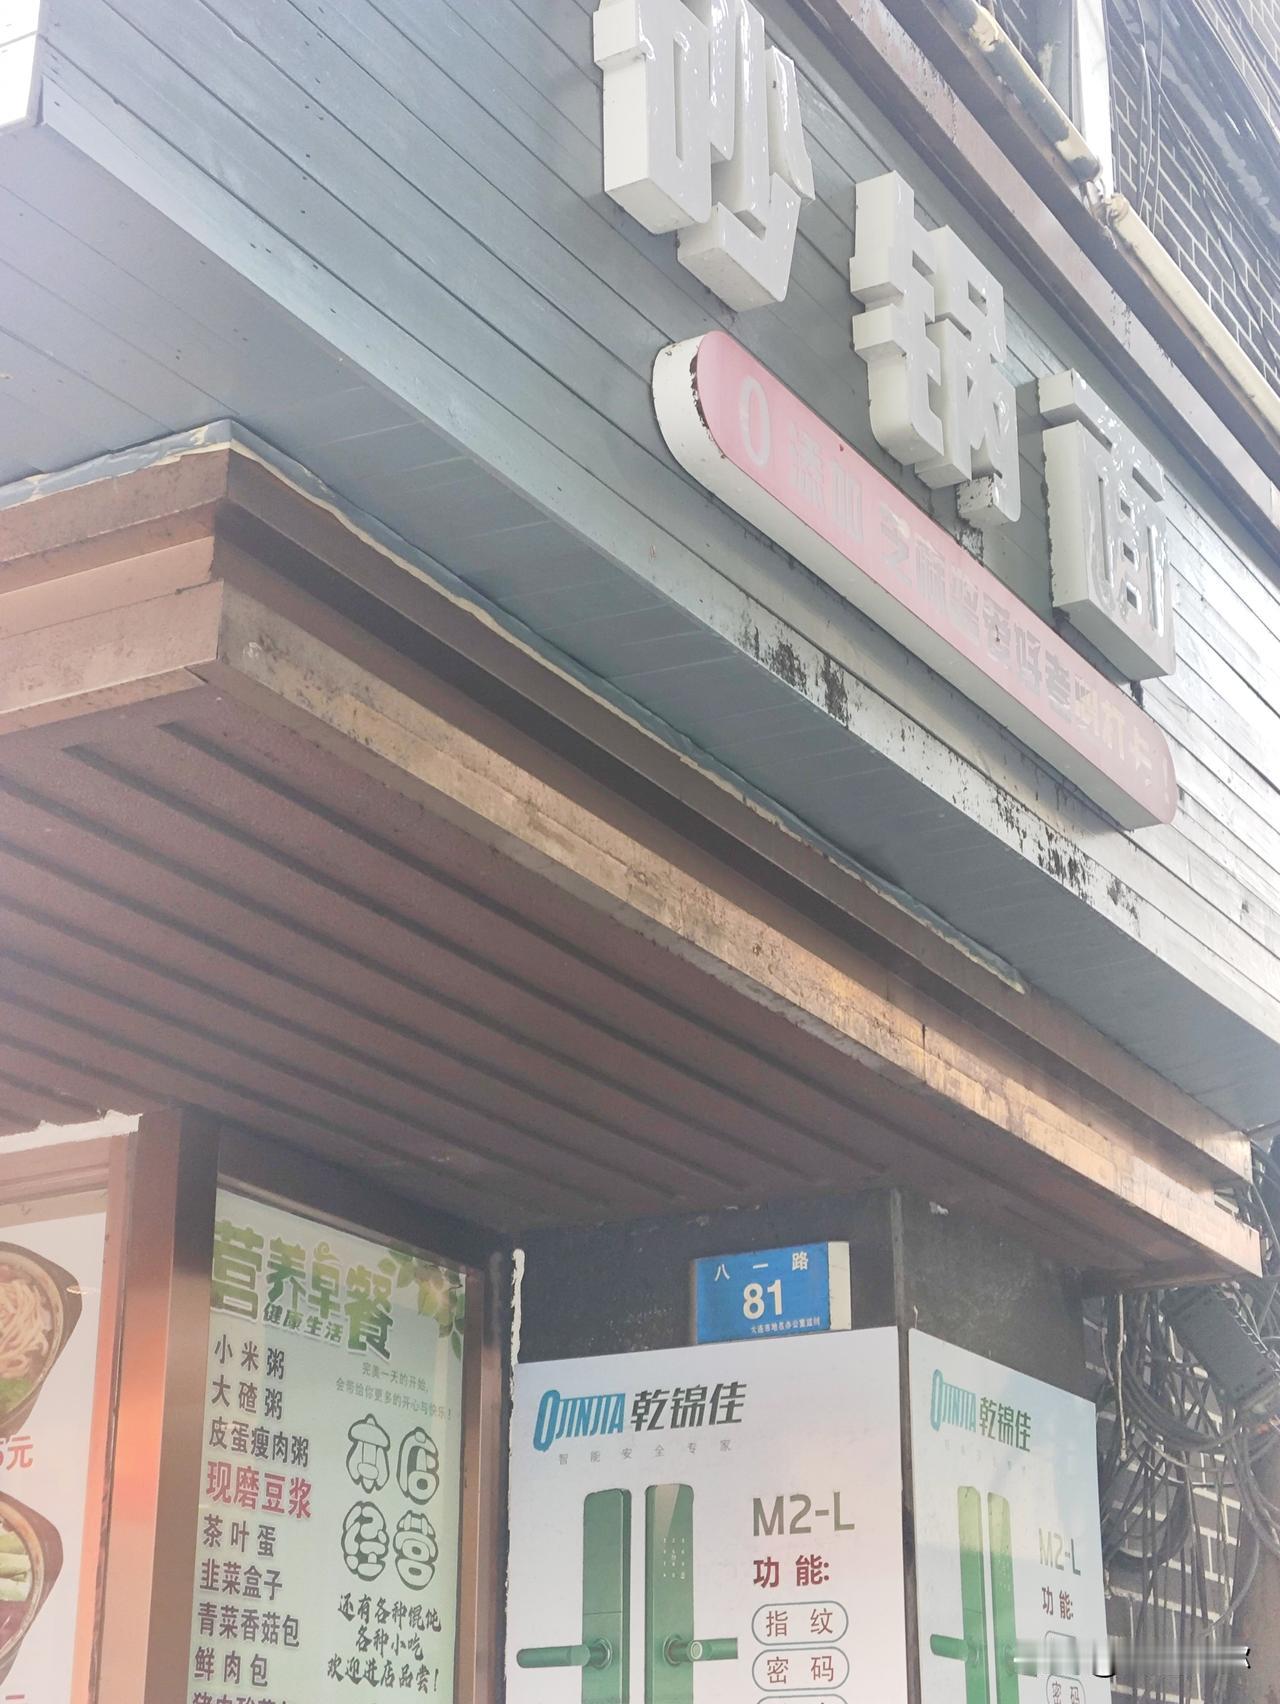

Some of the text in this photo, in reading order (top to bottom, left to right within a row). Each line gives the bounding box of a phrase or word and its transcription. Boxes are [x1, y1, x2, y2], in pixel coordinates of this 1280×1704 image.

[714, 1251, 809, 1282] 八一路
[209, 1219, 394, 1360] 营养早餐
[742, 1279, 783, 1320] 81
[263, 1303, 343, 1344] 健康生活
[214, 1334, 285, 1380] 小米粥
[211, 1374, 283, 1420] 大碴粥
[630, 1381, 748, 1432] 乾锦佳
[209, 1416, 309, 1468] 皮蛋瘦肉粥
[979, 1397, 1032, 1452] 乾锦佳
[346, 1413, 440, 1505] 本店
[559, 1440, 732, 1465] 智能安全专家
[206, 1460, 312, 1520] 现磨豆浆
[203, 1513, 276, 1557] 茶叶蛋
[752, 1491, 855, 1537] M2-L
[341, 1501, 438, 1591] 经营
[1038, 1528, 1082, 1577] M2-L
[199, 1558, 283, 1600] 韭菜盒子
[752, 1554, 830, 1589] 功能:
[197, 1602, 301, 1648] 青菜香菇包
[338, 1592, 441, 1632] 还有各种馄饨
[765, 1608, 833, 1637] 指纹
[356, 1624, 424, 1661] 各种小吃
[194, 1647, 268, 1687] 鲜肉包
[327, 1653, 439, 1694] 欢迎进店品尝!
[767, 1655, 834, 1684] 密码
